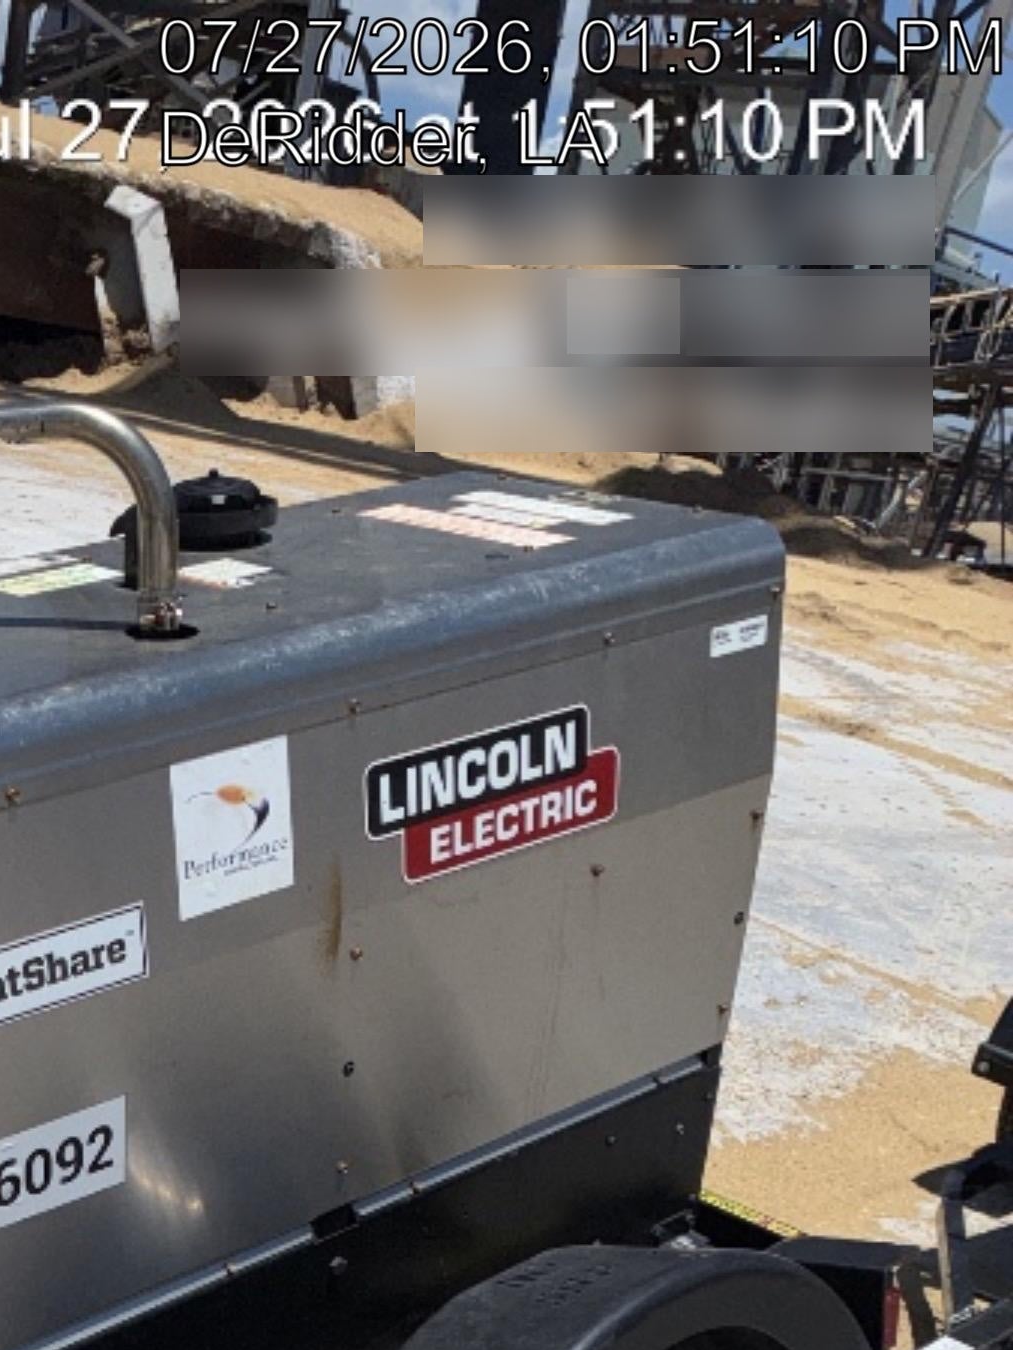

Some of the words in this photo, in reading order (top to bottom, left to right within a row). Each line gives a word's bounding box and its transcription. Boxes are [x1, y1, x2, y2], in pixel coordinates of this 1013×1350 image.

[379, 719, 577, 826] LINCOLN
[184, 837, 289, 880] Performance
[430, 779, 598, 864] ELECTRIC
